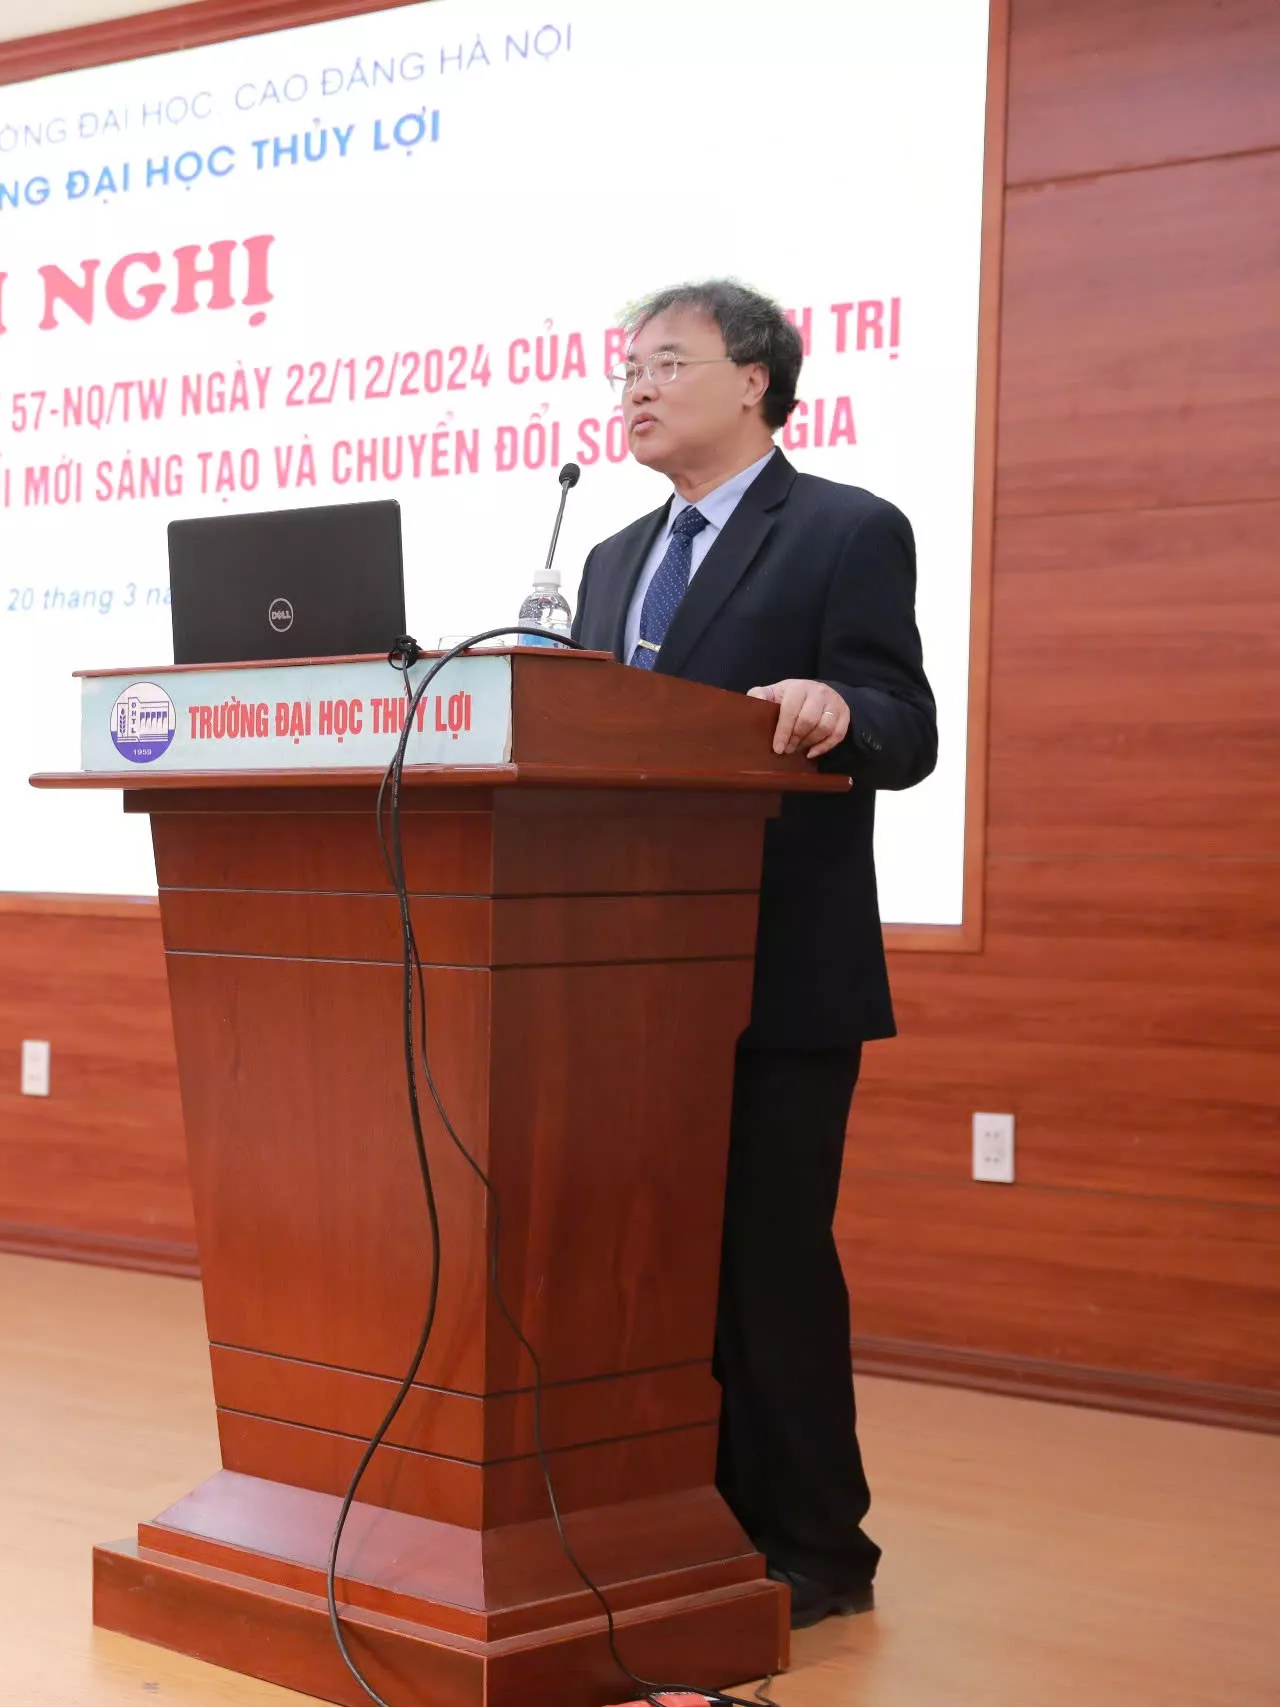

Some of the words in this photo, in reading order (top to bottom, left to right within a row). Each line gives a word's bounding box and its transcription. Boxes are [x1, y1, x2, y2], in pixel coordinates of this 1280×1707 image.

[234, 73, 308, 111] CAO
[439, 32, 491, 74] HÀ
[505, 22, 572, 62] NỘI
[65, 162, 130, 204] ĐẠI
[146, 145, 236, 191] HỌC
[251, 117, 356, 170] THỦY
[373, 105, 440, 157] LỢI
[37, 233, 276, 331] NGHỊ
[11, 377, 168, 433] 57-NQ/TW
[181, 360, 271, 416] NGÀY
[285, 343, 492, 407] 22/12/2024
[507, 318, 588, 385] CỦA
[830, 296, 901, 360] TRỊ
[24, 453, 83, 506] MỚI
[95, 449, 183, 502] SÁNG
[197, 447, 260, 503] TẠO
[274, 434, 317, 489] VÀ
[331, 410, 479, 486] CHUYỂN
[494, 402, 560, 472] ĐỔI
[782, 396, 857, 451] GIA
[7, 587, 35, 611] 20
[123, 581, 137, 607] 3
[133, 748, 152, 756] 1959
[188, 695, 268, 739] TRƯỜNG
[275, 700, 311, 744] ĐẠI
[318, 697, 363, 743] HỌC
[435, 690, 472, 740] LỢI
